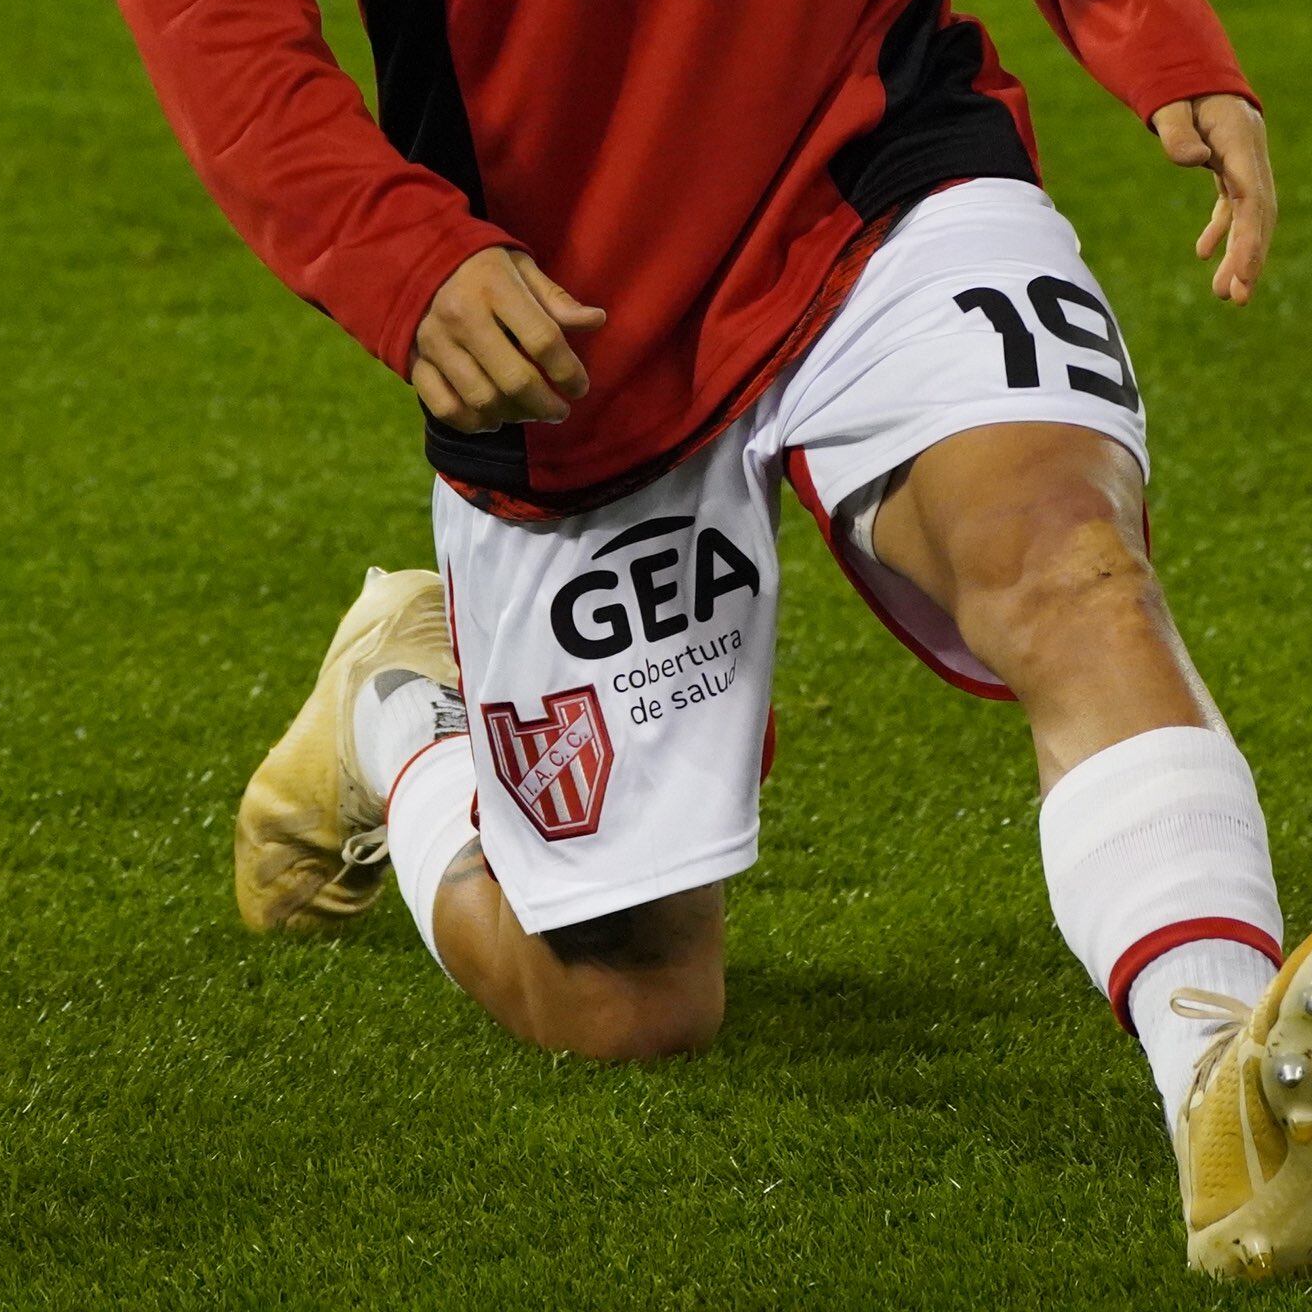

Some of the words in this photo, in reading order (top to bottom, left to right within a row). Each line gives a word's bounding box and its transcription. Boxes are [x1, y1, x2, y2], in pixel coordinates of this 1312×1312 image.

[952, 275, 1139, 415] 19
[550, 527, 761, 661] GEA
[613, 629, 743, 694] cobertura
[630, 696, 664, 725] de
[671, 657, 737, 710] salud
